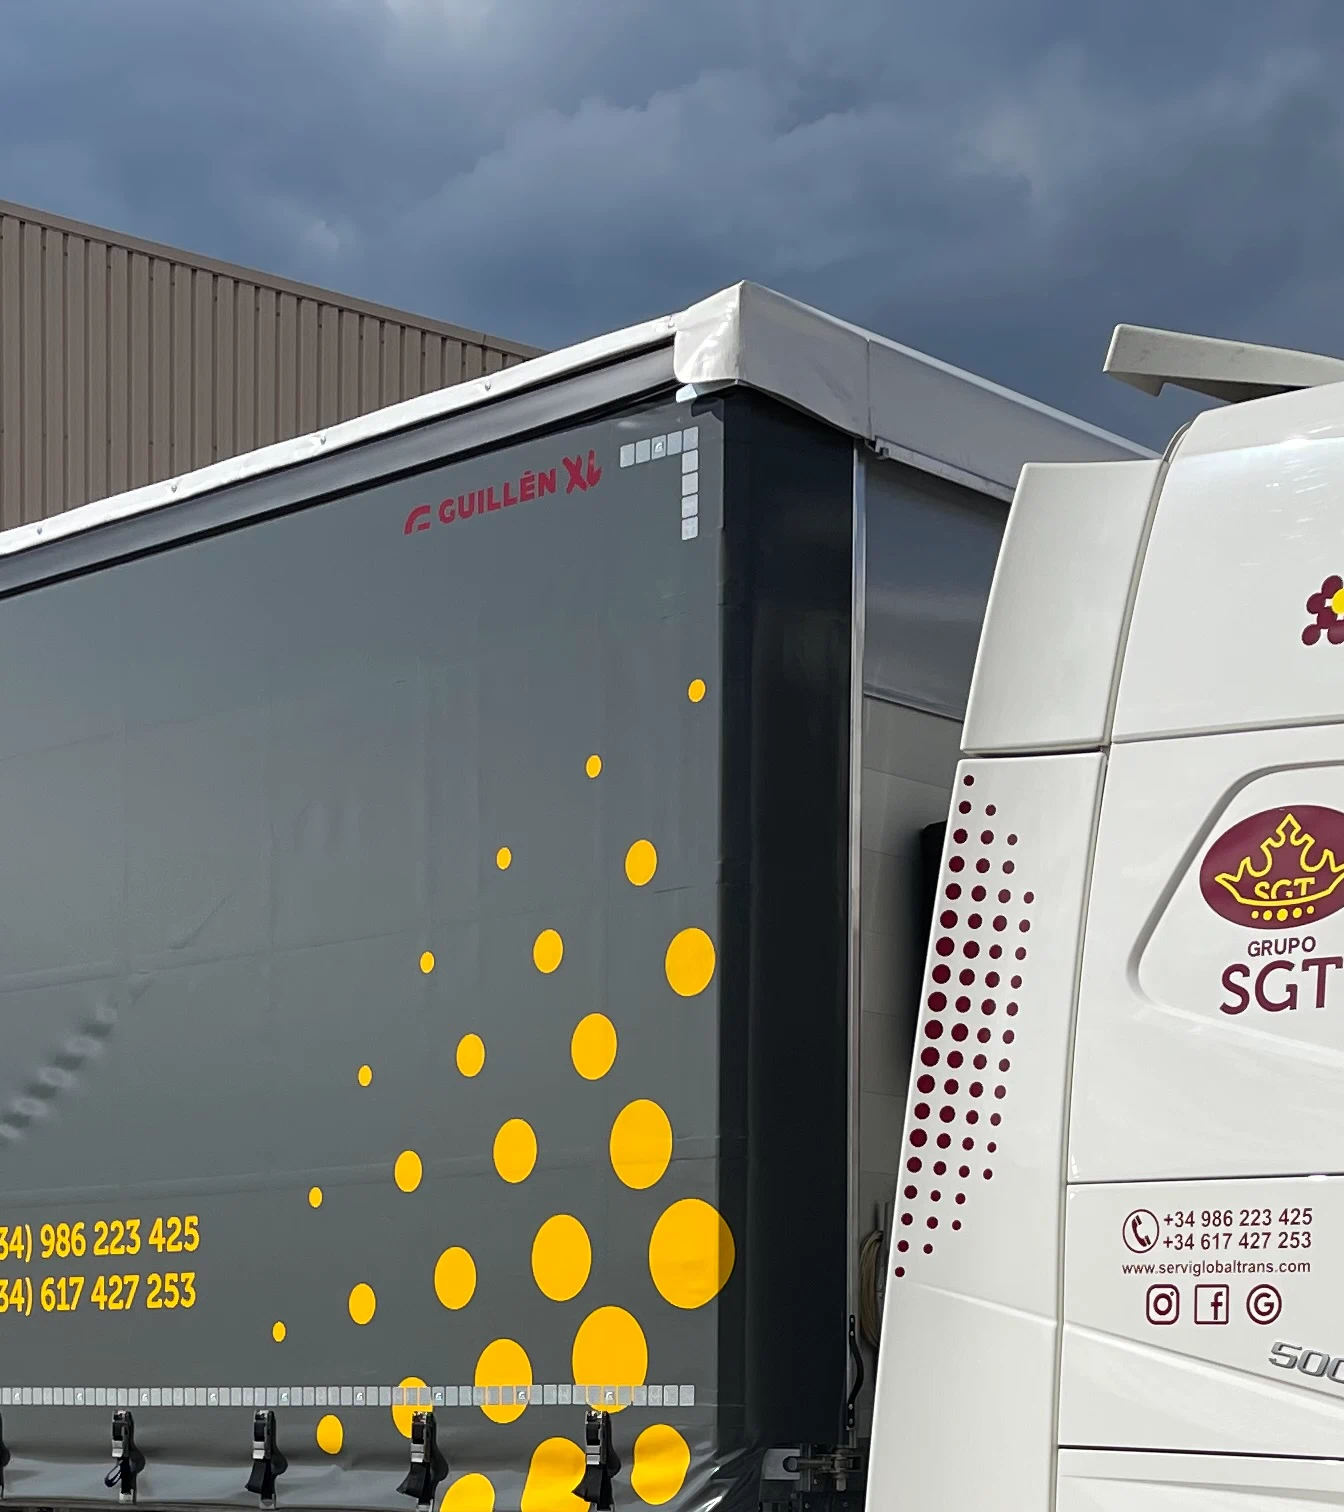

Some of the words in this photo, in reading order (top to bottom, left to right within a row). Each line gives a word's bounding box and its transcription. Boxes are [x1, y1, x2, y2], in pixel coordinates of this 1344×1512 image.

[1255, 877, 1316, 900] SGT
[1247, 936, 1317, 958] GRUPO
[1219, 956, 1344, 1015] SGT
[1163, 1210, 1196, 1228] +34
[1201, 1209, 1234, 1227] 986
[1239, 1208, 1272, 1227] 223
[1278, 1207, 1313, 1226] 425
[40, 1221, 86, 1259] 986
[93, 1218, 141, 1256] 223
[148, 1215, 200, 1253] 425
[1163, 1233, 1195, 1250] +34
[1200, 1233, 1233, 1251] 617
[1238, 1232, 1272, 1249] 427
[1278, 1231, 1312, 1249] 253
[1122, 1260, 1311, 1277] www.serviglobaltrans.com
[40, 1276, 85, 1311] 617
[91, 1274, 140, 1310] 427
[146, 1271, 197, 1308] 253
